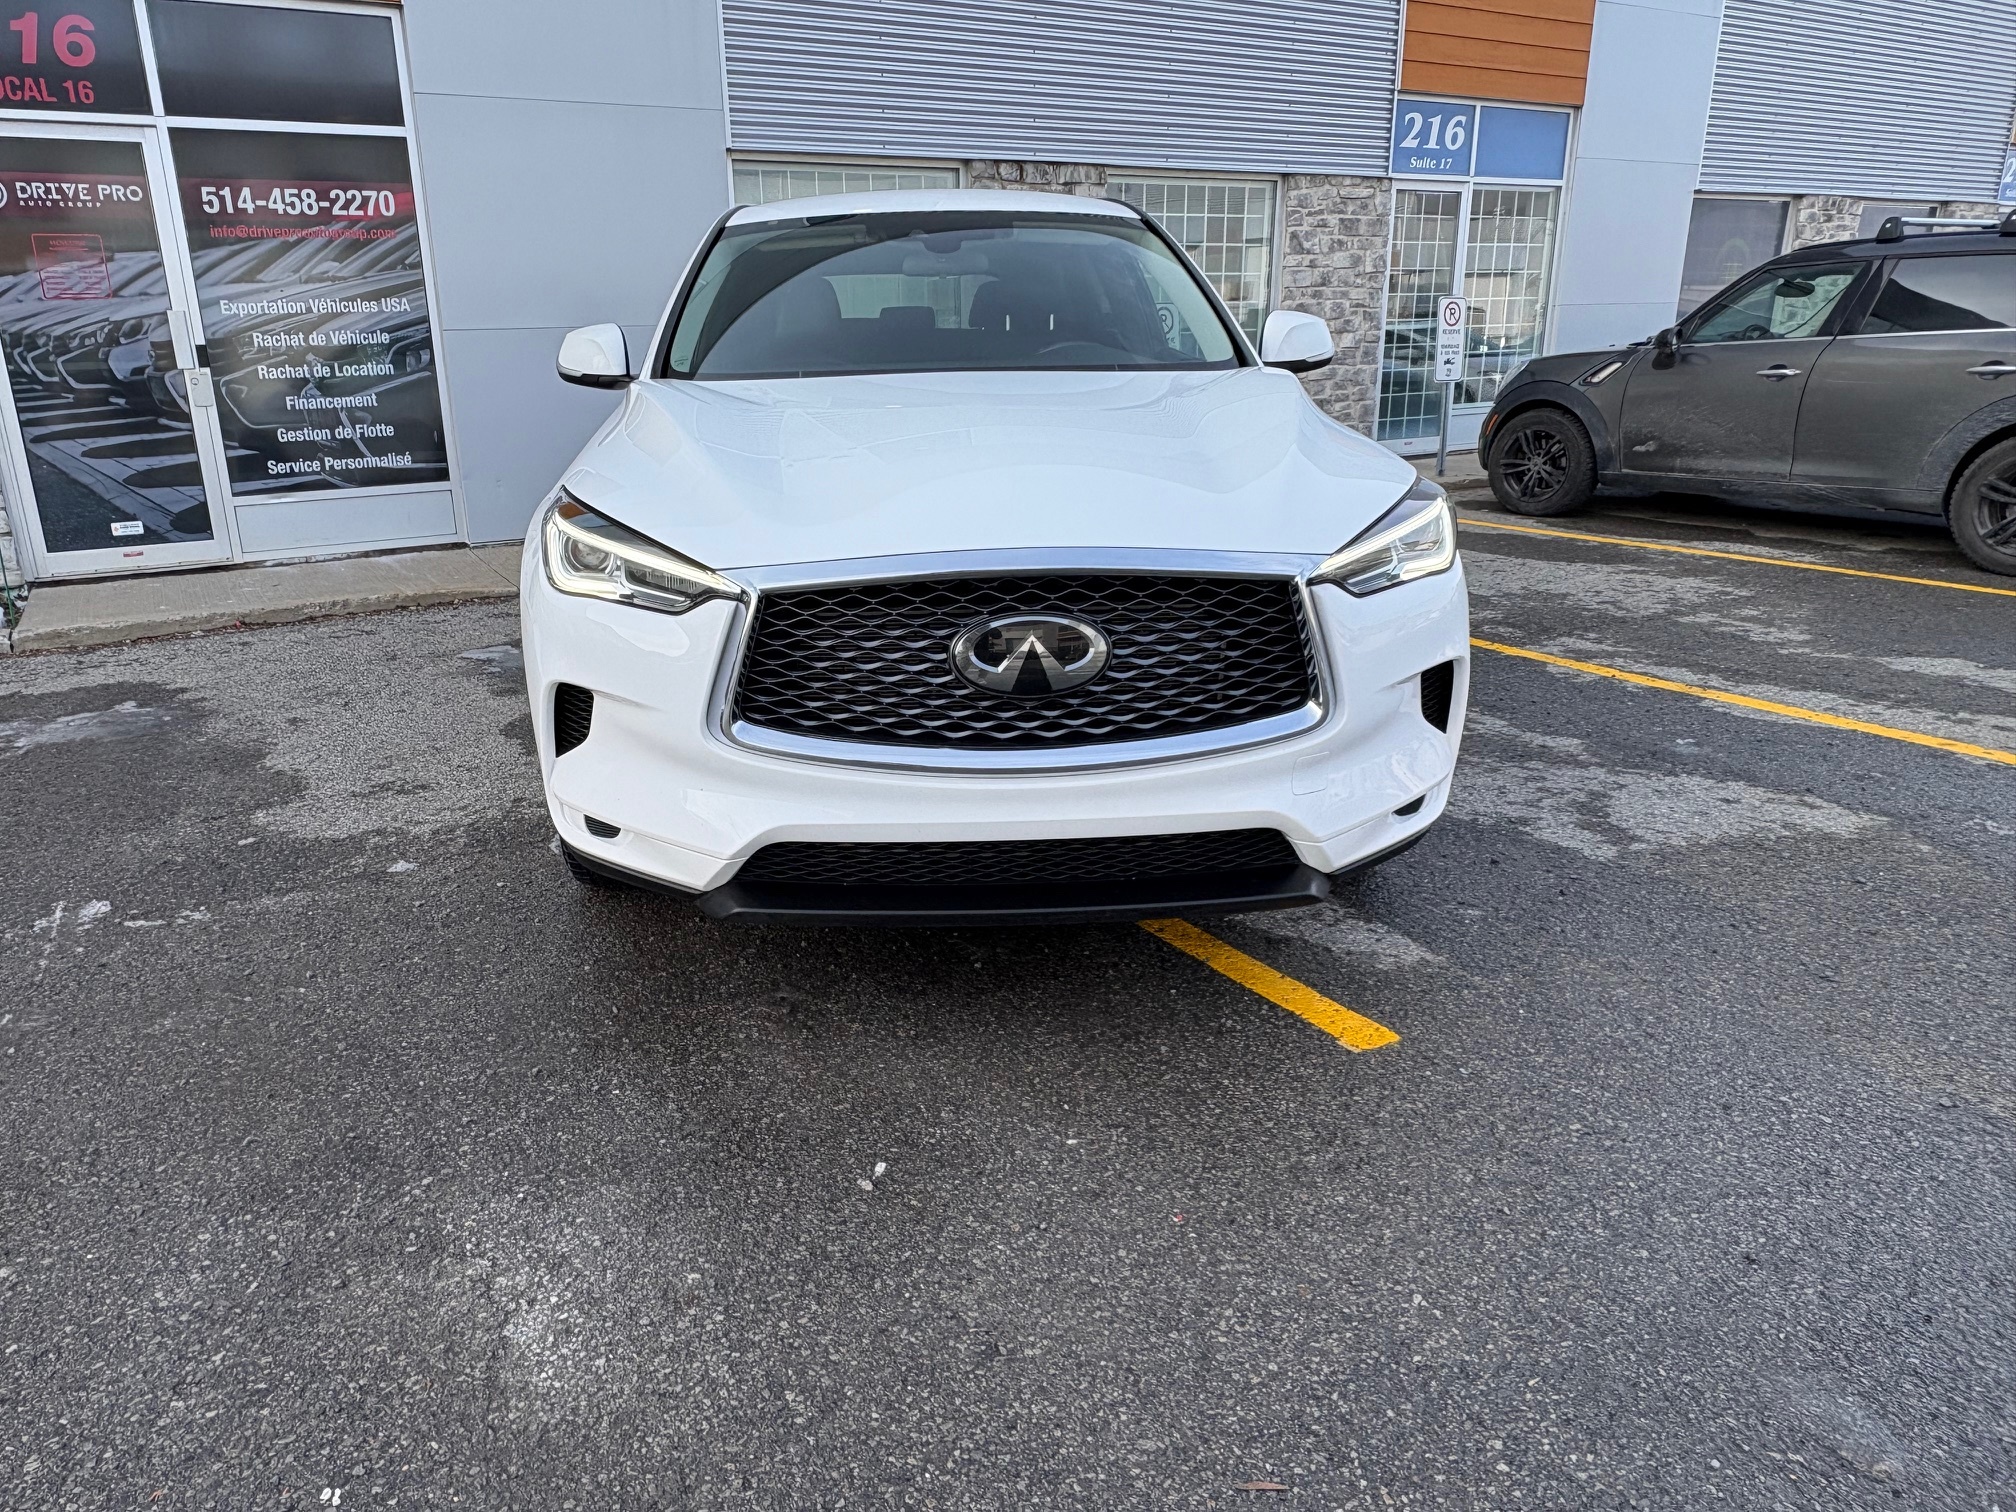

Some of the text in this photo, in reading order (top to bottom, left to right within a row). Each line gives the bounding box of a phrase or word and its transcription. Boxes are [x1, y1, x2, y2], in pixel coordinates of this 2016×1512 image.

[62, 80, 95, 104] 16
[1399, 112, 1467, 150] 216
[1409, 156, 1452, 169] Suite 17
[15, 182, 143, 202] DRIVE PRO
[201, 186, 396, 217] 514-458-2270
[220, 297, 411, 317] Exportation Véhicules USA
[252, 330, 390, 348] Rachat de Véhicule
[257, 361, 394, 380] Rachat de Location
[285, 393, 378, 411] Financement
[277, 423, 395, 443] Gestion de Flotte
[267, 451, 412, 475] Service Personnalisé
